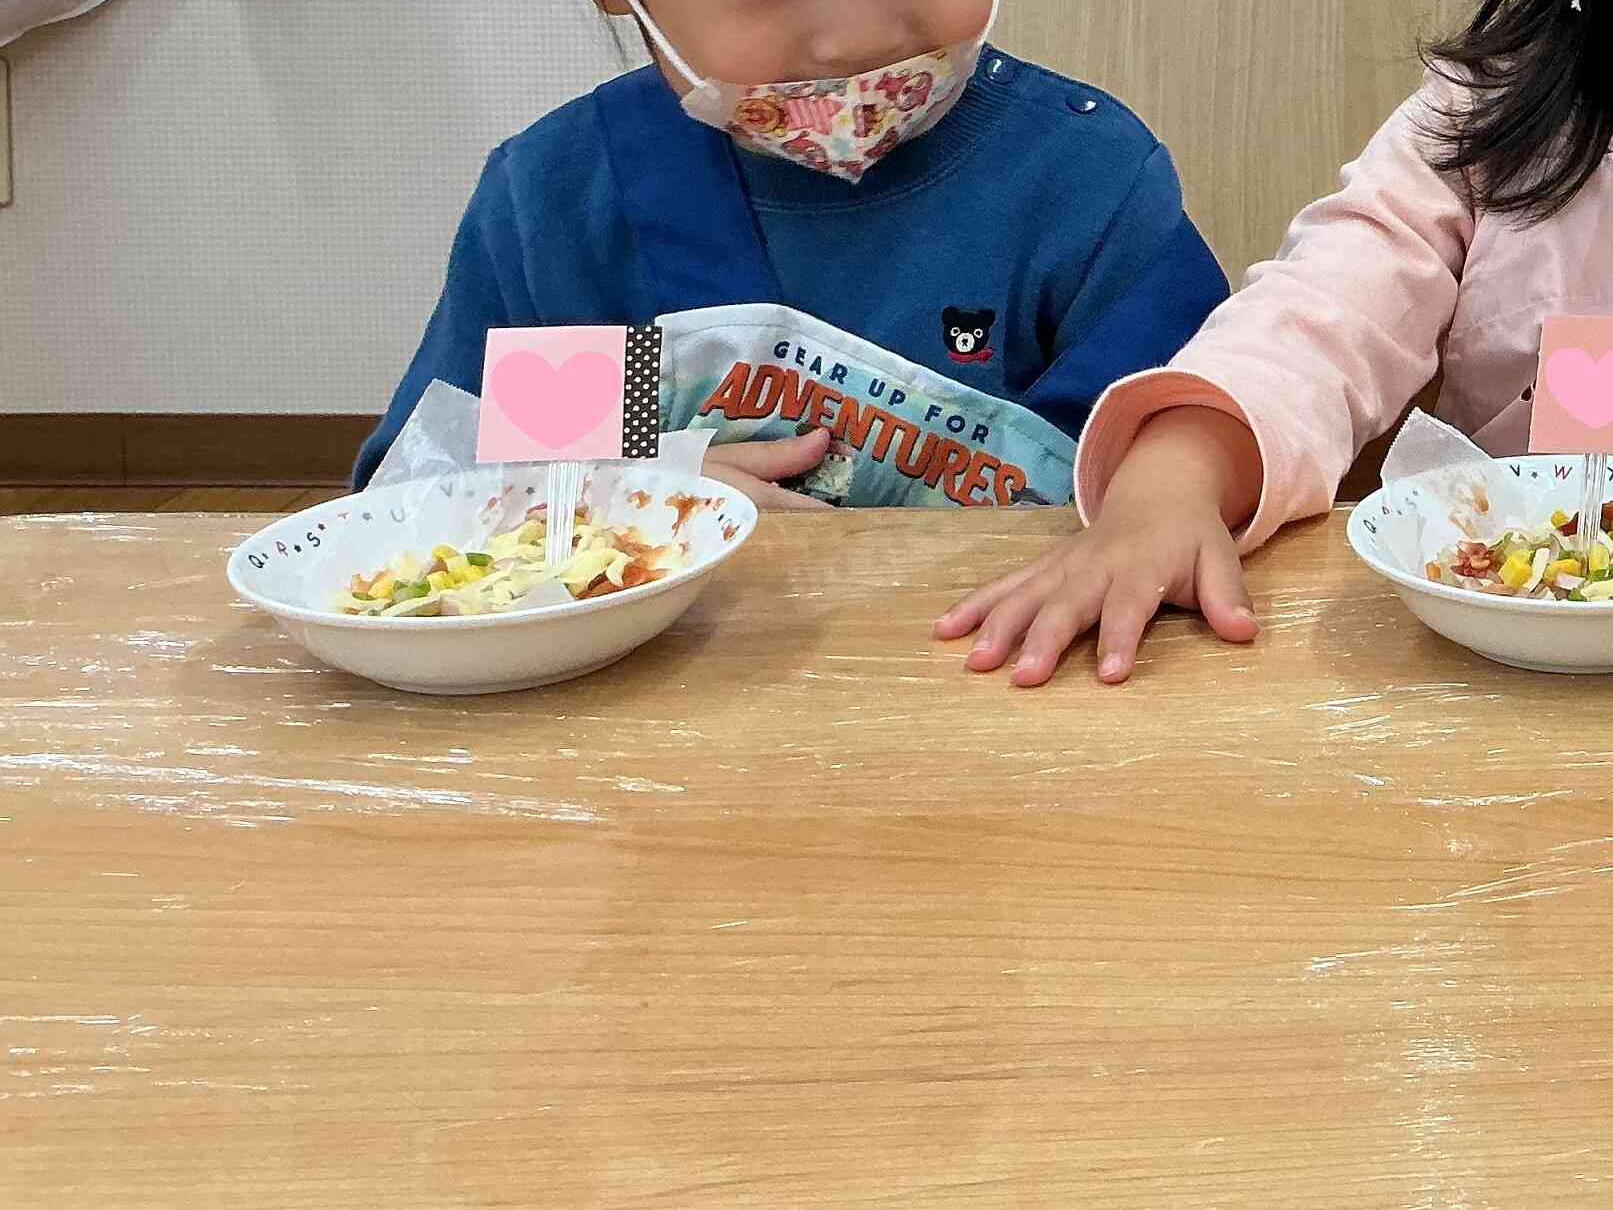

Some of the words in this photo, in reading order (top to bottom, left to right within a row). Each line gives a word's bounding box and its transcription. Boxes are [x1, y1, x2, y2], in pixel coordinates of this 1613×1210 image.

[700, 361, 1028, 507] ADVENTURES
[773, 340, 848, 385] GEAR
[869, 378, 906, 406] UP
[924, 405, 991, 444] FOR
